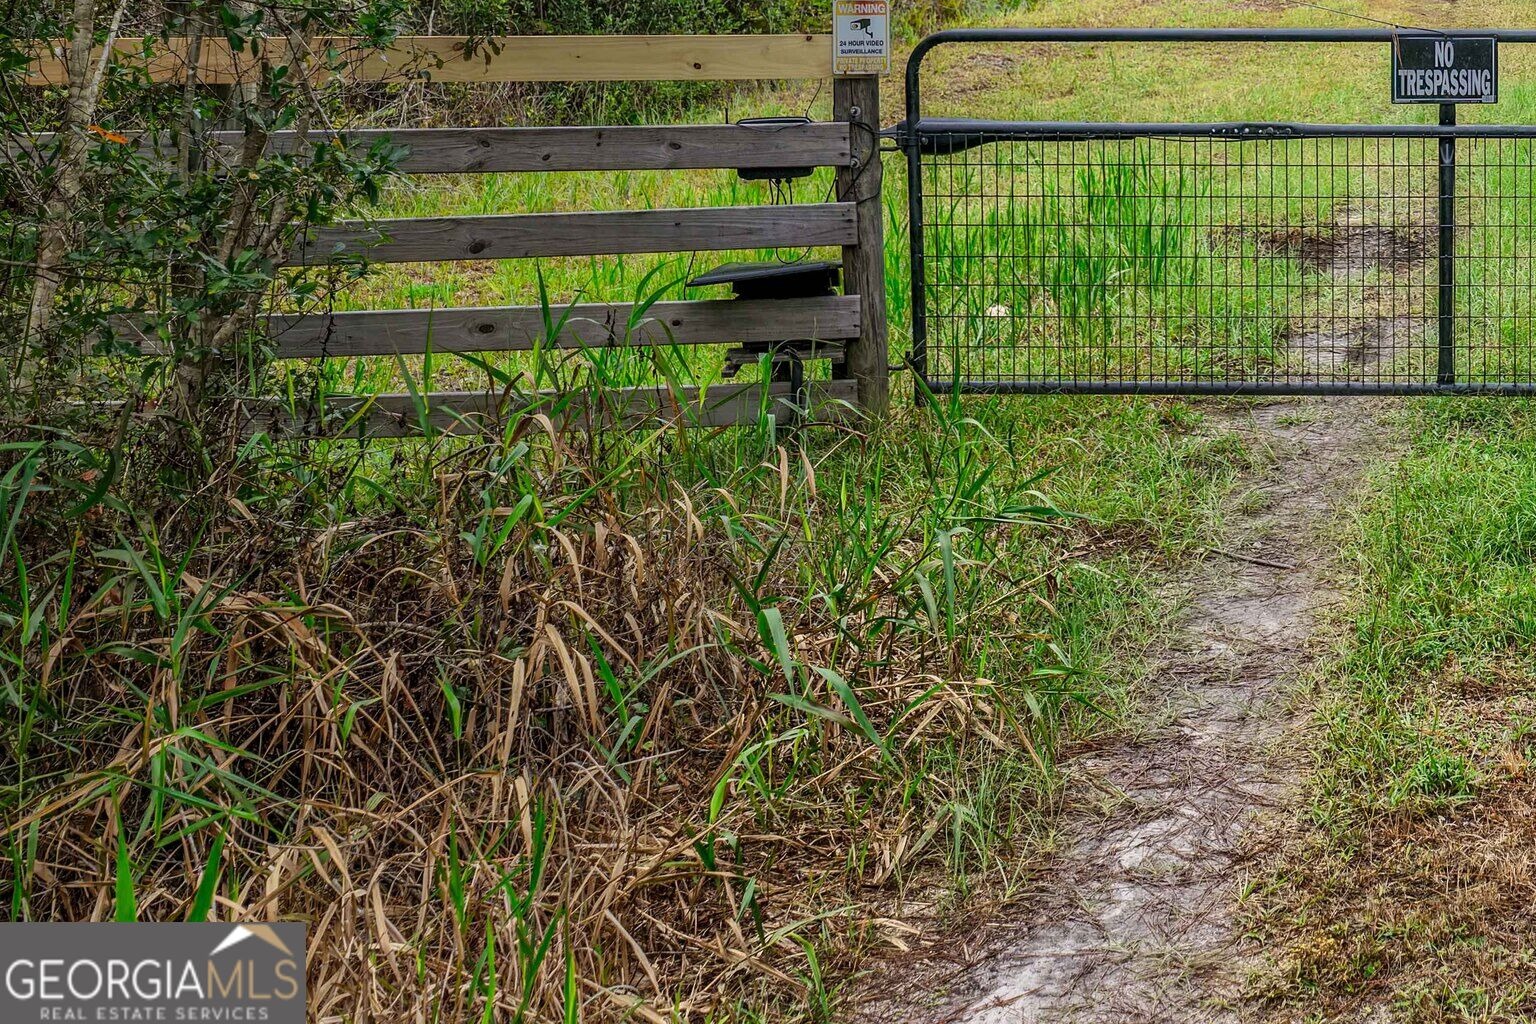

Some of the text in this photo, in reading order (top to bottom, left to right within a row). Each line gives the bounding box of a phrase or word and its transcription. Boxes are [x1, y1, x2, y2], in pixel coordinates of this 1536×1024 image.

[838, 3, 886, 14] WARNING
[1434, 41, 1454, 68] NO
[1398, 69, 1491, 96] TRESPASSING
